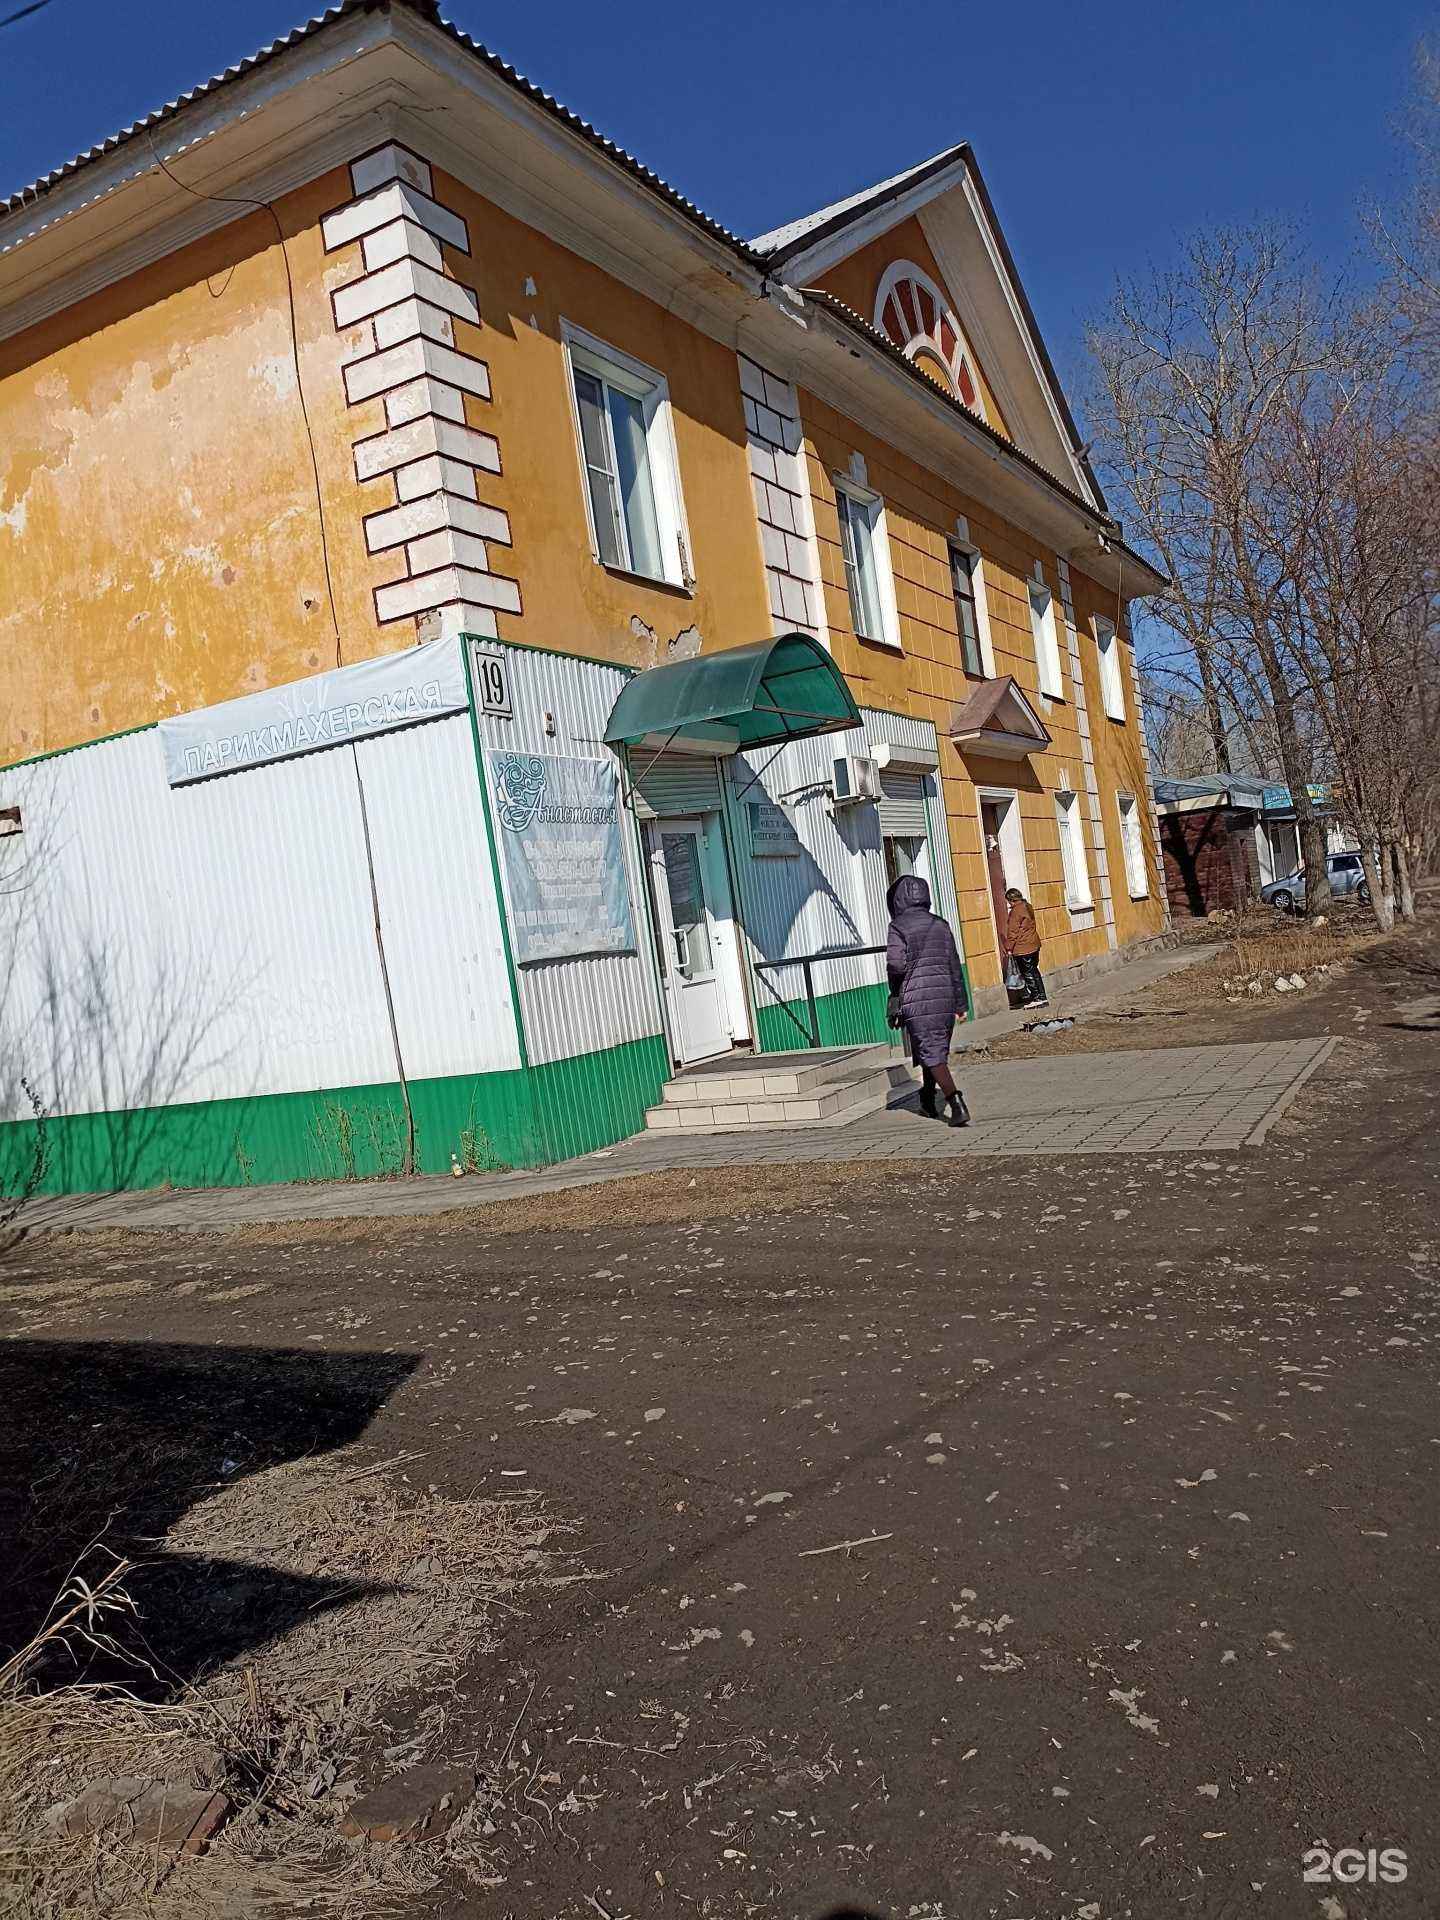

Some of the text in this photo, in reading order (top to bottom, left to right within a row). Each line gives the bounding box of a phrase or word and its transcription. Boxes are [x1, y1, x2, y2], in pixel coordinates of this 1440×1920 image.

[482, 659, 504, 705] 19
[183, 680, 442, 775] ПАРИКМАХЕРСКАЯ
[524, 787, 619, 825] Анастасия
